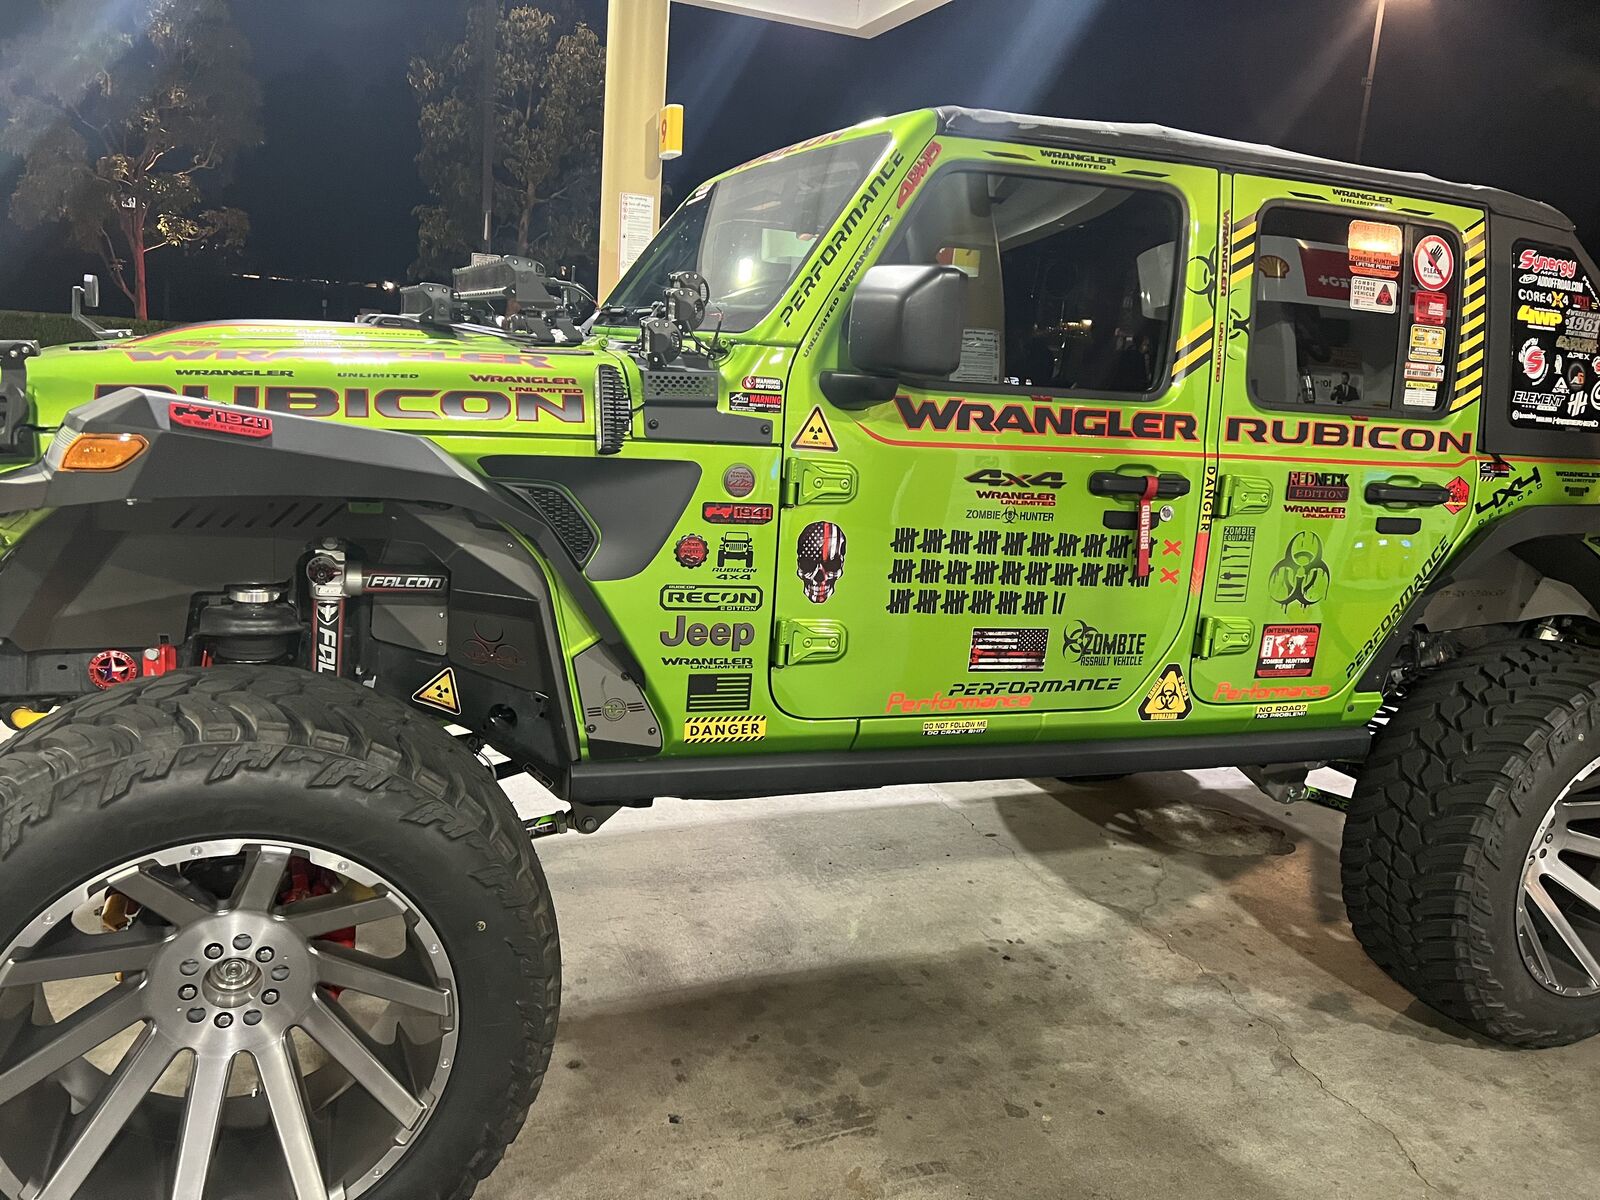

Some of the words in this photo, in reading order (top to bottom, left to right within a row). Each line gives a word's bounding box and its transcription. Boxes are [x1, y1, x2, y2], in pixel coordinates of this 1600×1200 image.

[661, 118, 667, 144] 9
[1040, 149, 1117, 167] WRANGLER
[1051, 159, 1107, 170] UNLIMITED
[1332, 188, 1393, 204] WRANGLER
[778, 148, 904, 328] PERFORMANCE
[1220, 209, 1231, 297] WRANGLER
[1374, 258, 1398, 266] HUNTING
[1518, 249, 1577, 279] Synergy
[803, 297, 840, 358] UNLIMITED
[838, 214, 892, 293] WRANGLER
[1517, 304, 1562, 326] 4WP
[1568, 316, 1600, 332] 1961
[123, 350, 557, 369] WRANGLER
[1215, 322, 1224, 383] UNLIMITED
[1567, 352, 1590, 360] APEX
[175, 369, 294, 377] WRANGLER
[468, 374, 577, 385] WRANGLER
[749, 394, 782, 404] WARNING
[1512, 390, 1566, 406] ELEMENT
[216, 410, 269, 430] 1941
[893, 395, 1200, 442] WRANGLER
[1224, 416, 1474, 454] RUBICON
[1288, 471, 1350, 487] REDNECK
[976, 490, 1056, 500] WRANGLER
[1200, 466, 1216, 532] DANGER
[1295, 488, 1346, 498] EDITION
[735, 506, 770, 518] 1941
[966, 510, 1001, 520] ZOMBIE
[1020, 512, 1054, 522] HUNTER
[1283, 504, 1346, 514] WRANGLER
[1140, 504, 1150, 550] BADLAND
[1224, 527, 1255, 535] ZOMBIE
[371, 576, 441, 588] FALCON
[668, 592, 756, 604] RECON
[1346, 535, 1449, 678] PERFORMANCE
[660, 616, 755, 652] Jeep
[318, 627, 337, 673] FAL
[1082, 634, 1146, 655] ZOMBIE
[662, 657, 752, 666] WRANGLER
[1080, 656, 1111, 666] ASSAULT
[1114, 656, 1143, 666] VEHICLE
[948, 678, 1122, 696] PERFORMANCE
[1213, 682, 1331, 700] Performance
[886, 692, 1033, 714] Performance
[690, 723, 760, 736] DANGER
